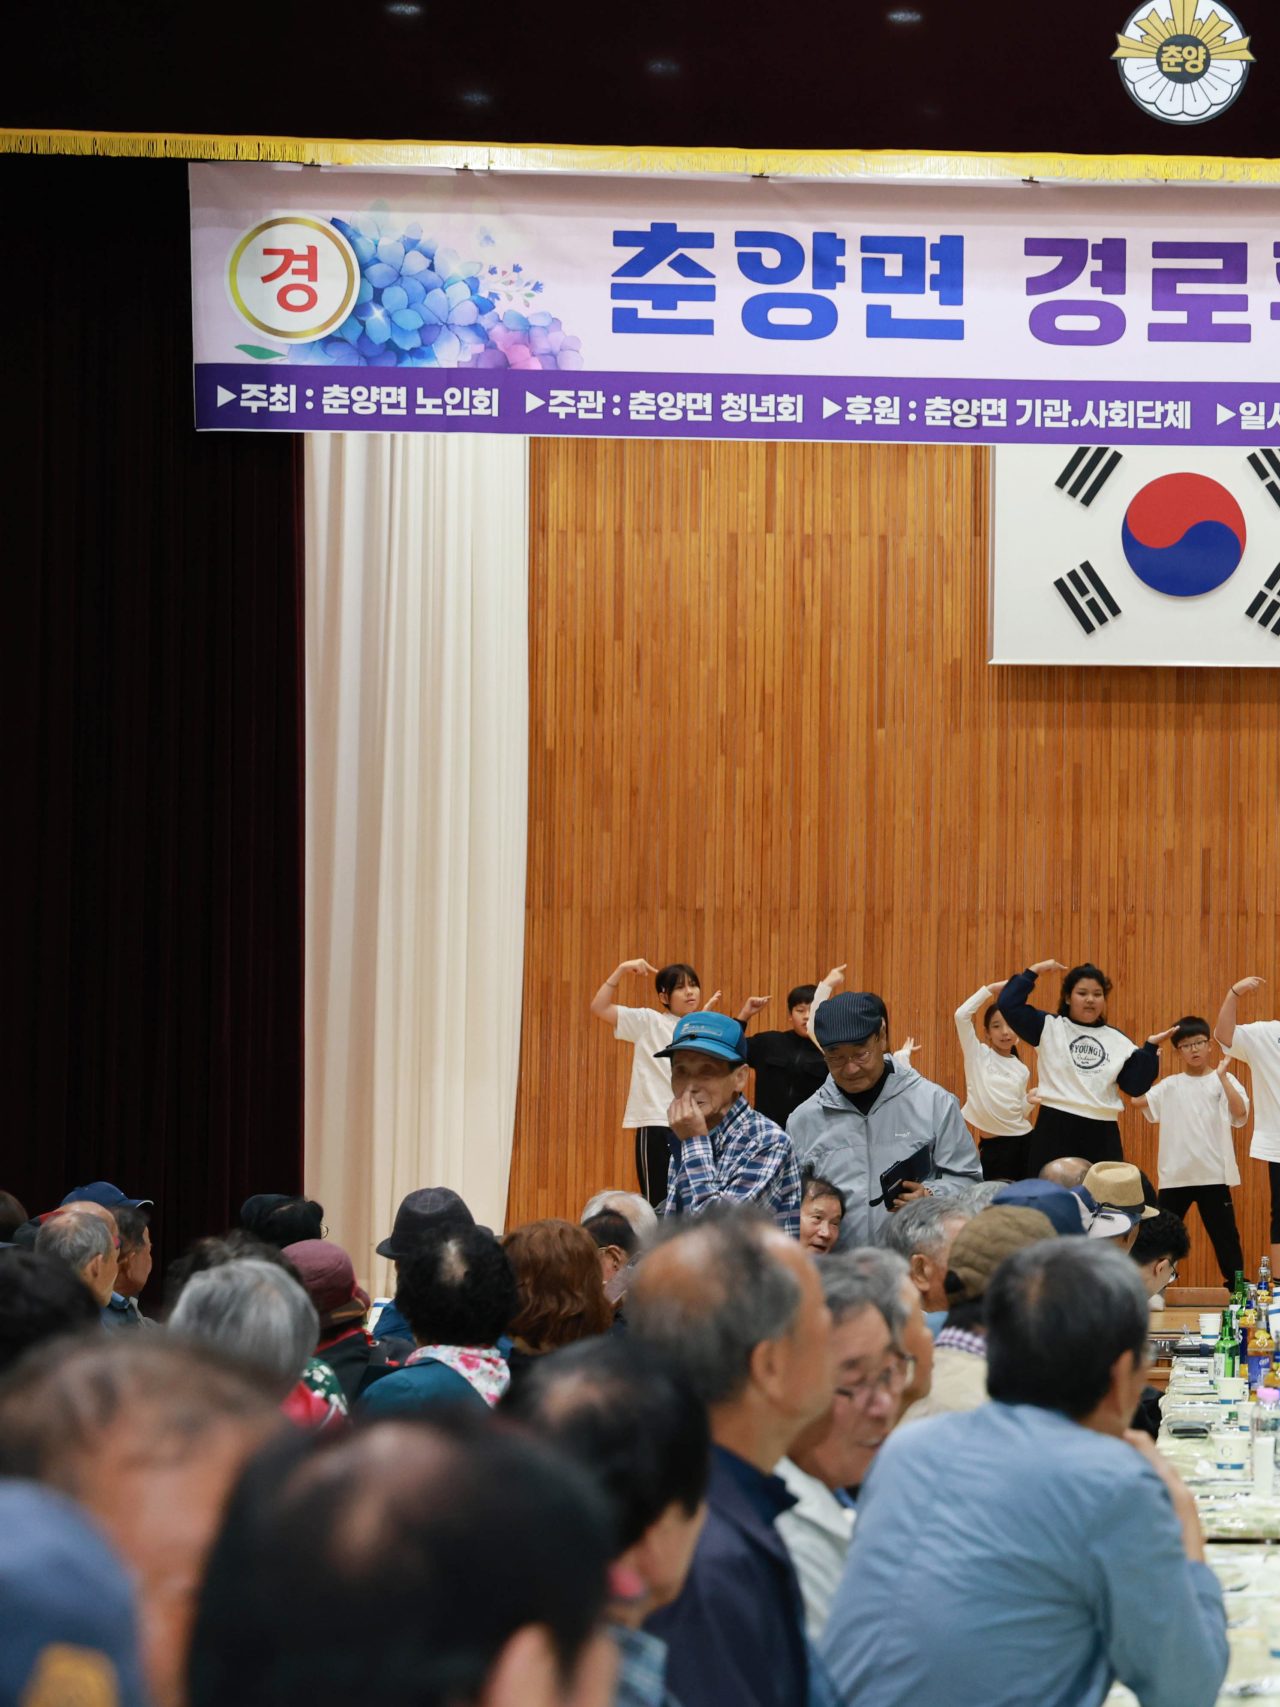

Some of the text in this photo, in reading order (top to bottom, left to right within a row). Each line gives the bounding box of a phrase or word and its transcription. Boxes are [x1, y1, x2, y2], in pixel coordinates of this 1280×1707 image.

[1161, 45, 1207, 74] 춘양
[261, 245, 319, 313] 경
[610, 222, 965, 341] 춘양면
[239, 383, 297, 414] 주최
[321, 384, 408, 416] 춘양면
[415, 386, 500, 417] 노인회
[548, 389, 607, 420] 주관
[628, 390, 713, 422] 춘양면
[720, 392, 804, 424] 청년회
[844, 394, 901, 426] 후원
[924, 396, 1008, 429] 춘양면
